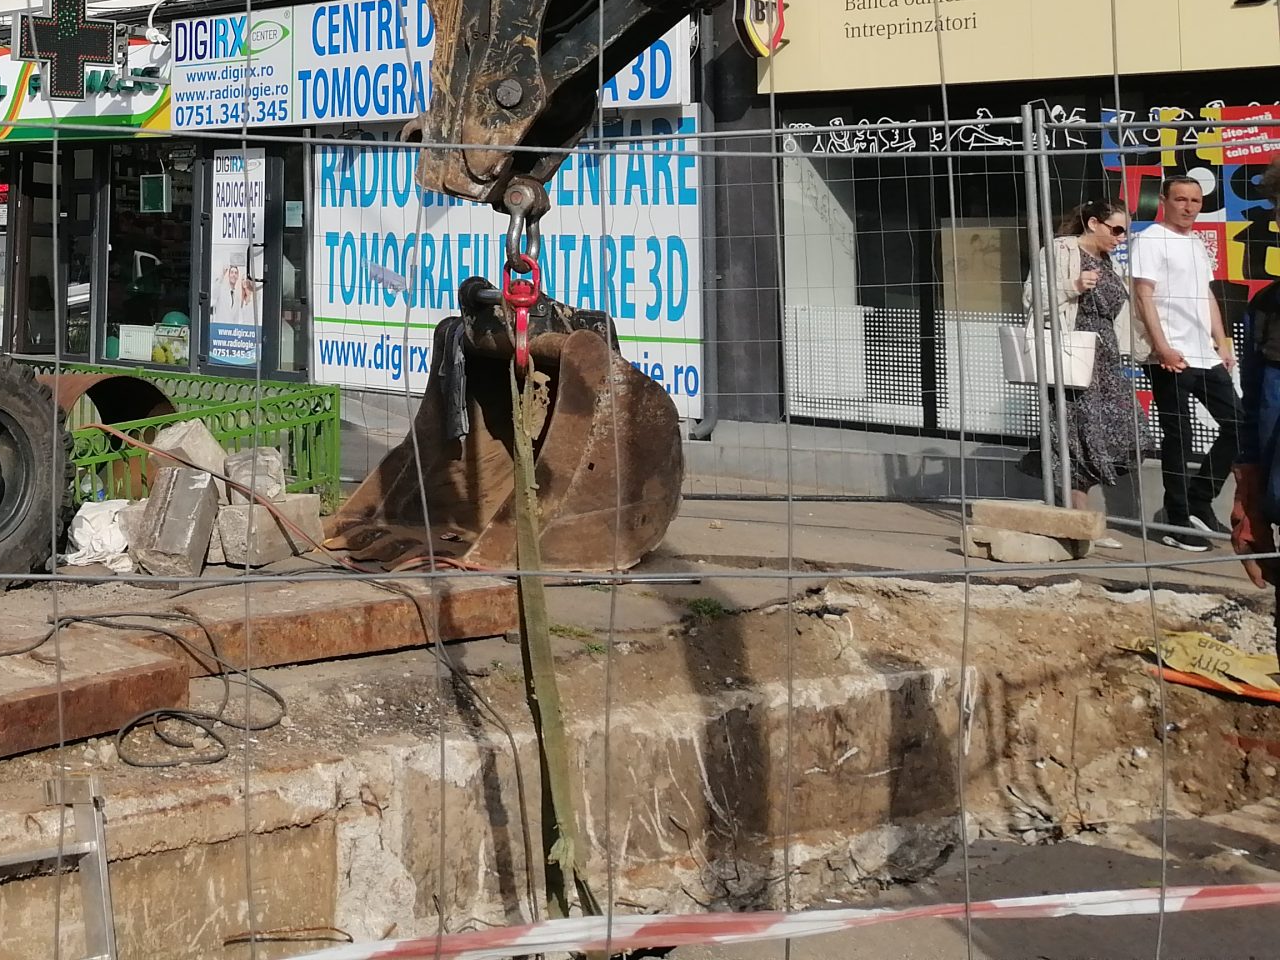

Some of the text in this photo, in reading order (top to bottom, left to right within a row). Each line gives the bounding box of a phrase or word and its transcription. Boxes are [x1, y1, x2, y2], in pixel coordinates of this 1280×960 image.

[753, 0, 777, 23] BT
[175, 15, 278, 62] DIGIRX CENTER
[844, 12, 978, 40] întreprinzători
[186, 64, 274, 83] www.digirx.ro
[627, 39, 673, 102] 3D
[175, 82, 289, 103] www.radiologie.ro
[175, 99, 289, 127] 0751.345.345
[215, 155, 245, 173] DIGIRX
[543, 117, 698, 206] ENTARE
[215, 180, 264, 208] RADIOGAFII
[222, 212, 256, 239] DENTAE
[325, 231, 489, 311] TOMOGRAFII
[645, 234, 689, 322] 3D
[212, 338, 256, 350] www.radiologie.
[217, 327, 256, 339] www.digirx.ro
[212, 347, 256, 360] 0751.345.34
[319, 333, 430, 381] www.digrx
